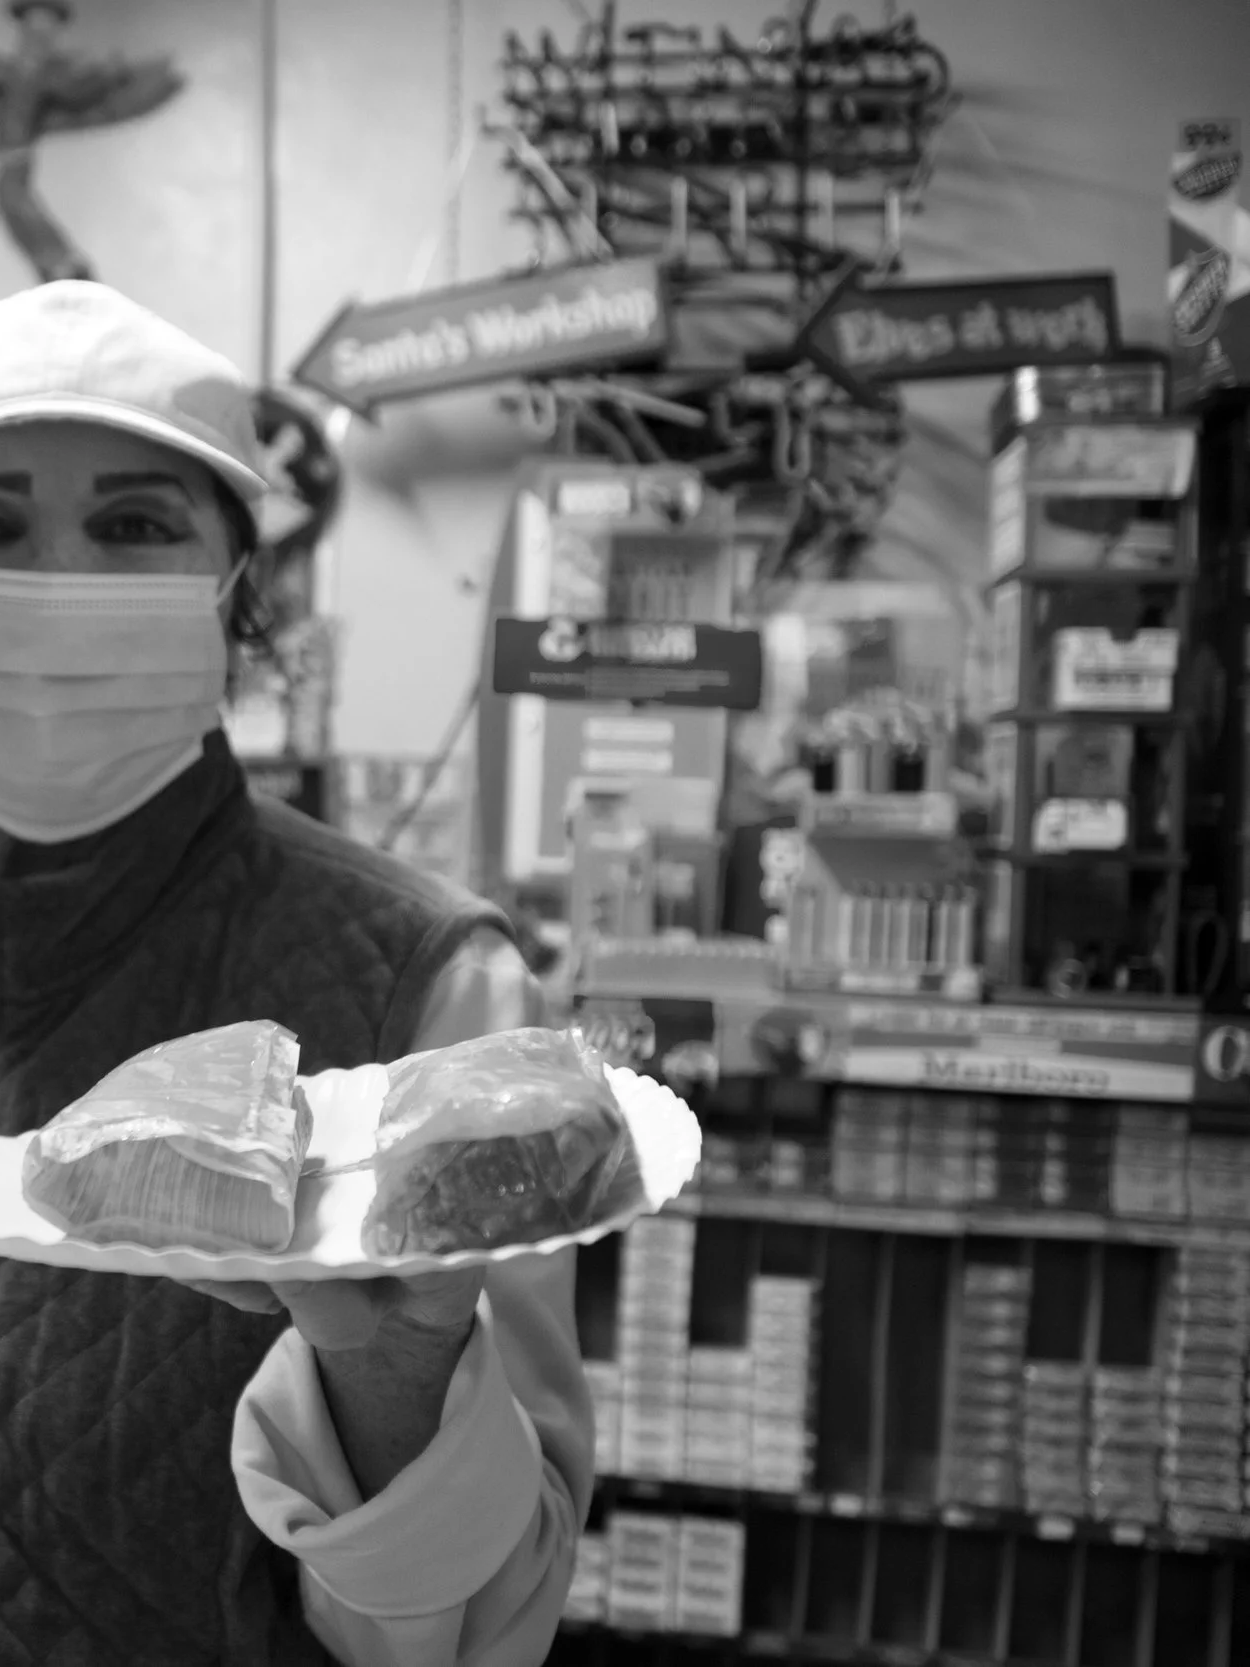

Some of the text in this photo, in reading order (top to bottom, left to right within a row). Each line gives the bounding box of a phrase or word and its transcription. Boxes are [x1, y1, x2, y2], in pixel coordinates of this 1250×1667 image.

[468, 286, 655, 355] Workshop
[958, 300, 1002, 348] at
[923, 1050, 1111, 1096] Marlboro
